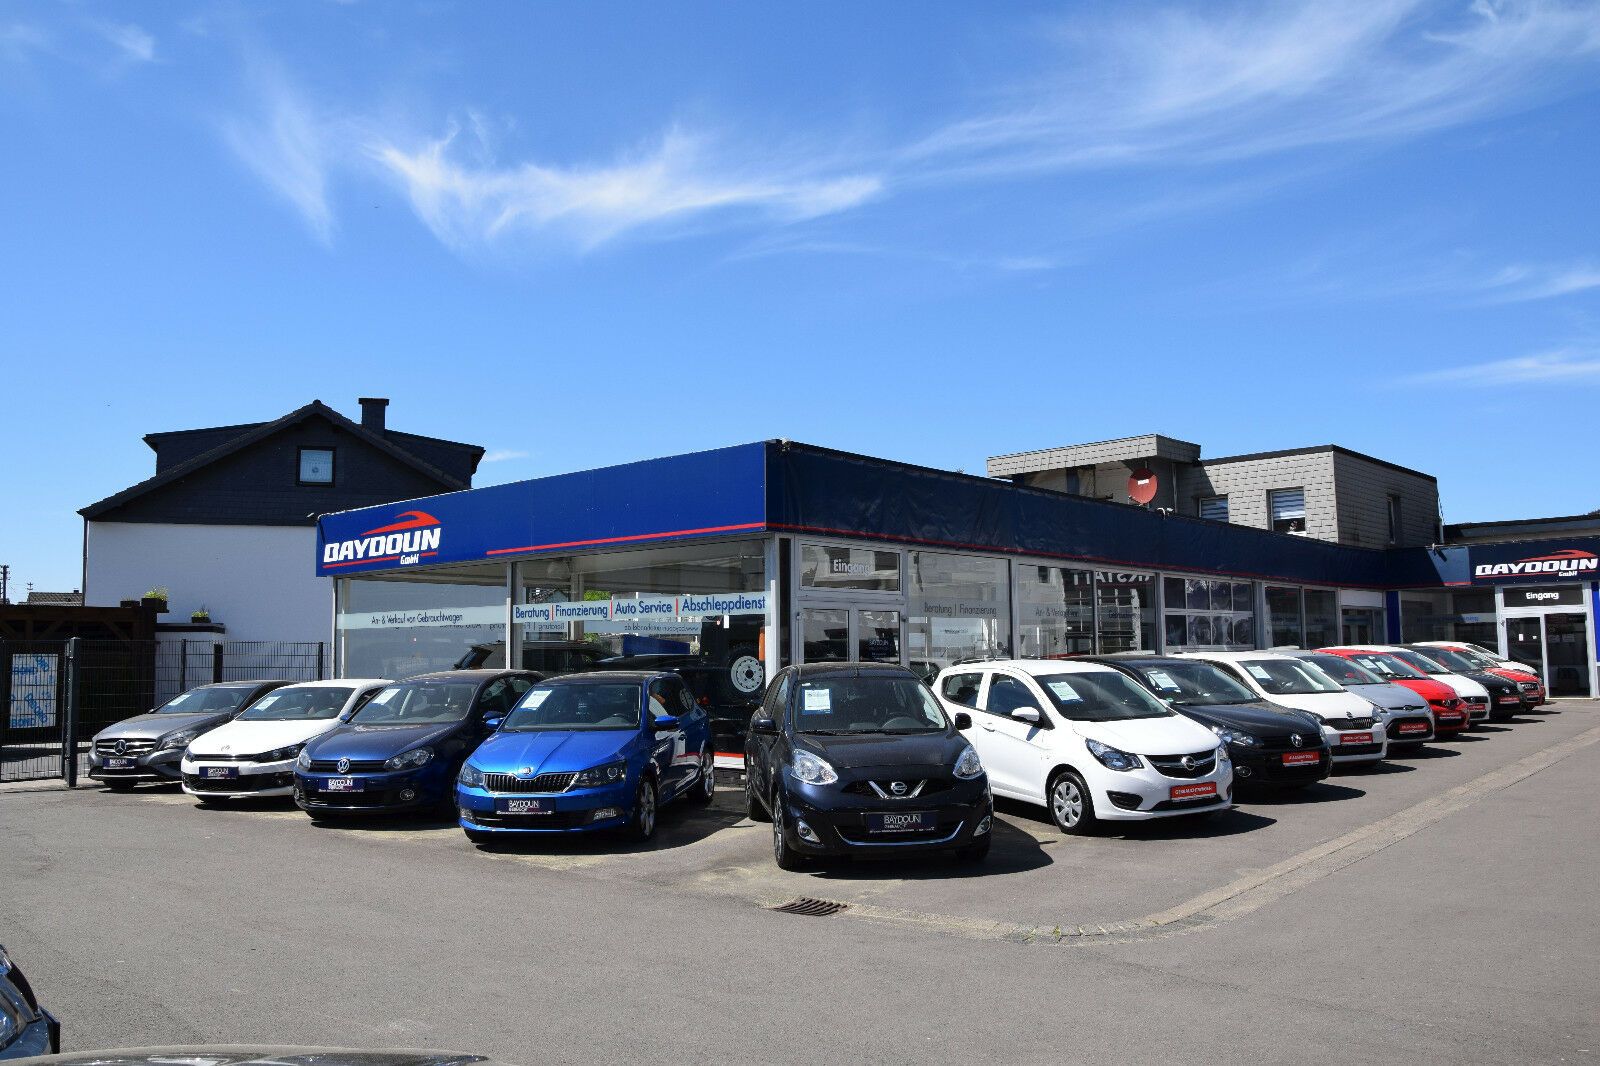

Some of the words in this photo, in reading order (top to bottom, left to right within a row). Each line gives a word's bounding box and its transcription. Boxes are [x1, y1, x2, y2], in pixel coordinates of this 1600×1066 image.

[400, 553, 420, 565] GmbH
[833, 558, 872, 577] Eingang
[1475, 558, 1598, 576] BAYDOUN
[1525, 592, 1559, 601] Eingang
[515, 606, 550, 620] Beratung
[556, 604, 608, 617] Finanzierung
[614, 602, 637, 615] Auto
[638, 600, 673, 613] Service
[681, 595, 767, 614] Abschleppdienst
[924, 602, 953, 617] Beratung
[959, 603, 997, 617] Finanzierung
[416, 610, 464, 625] Gebrauchtwagen
[508, 799, 540, 809] BAYDOUN
[884, 814, 921, 824] BAYDOUN
